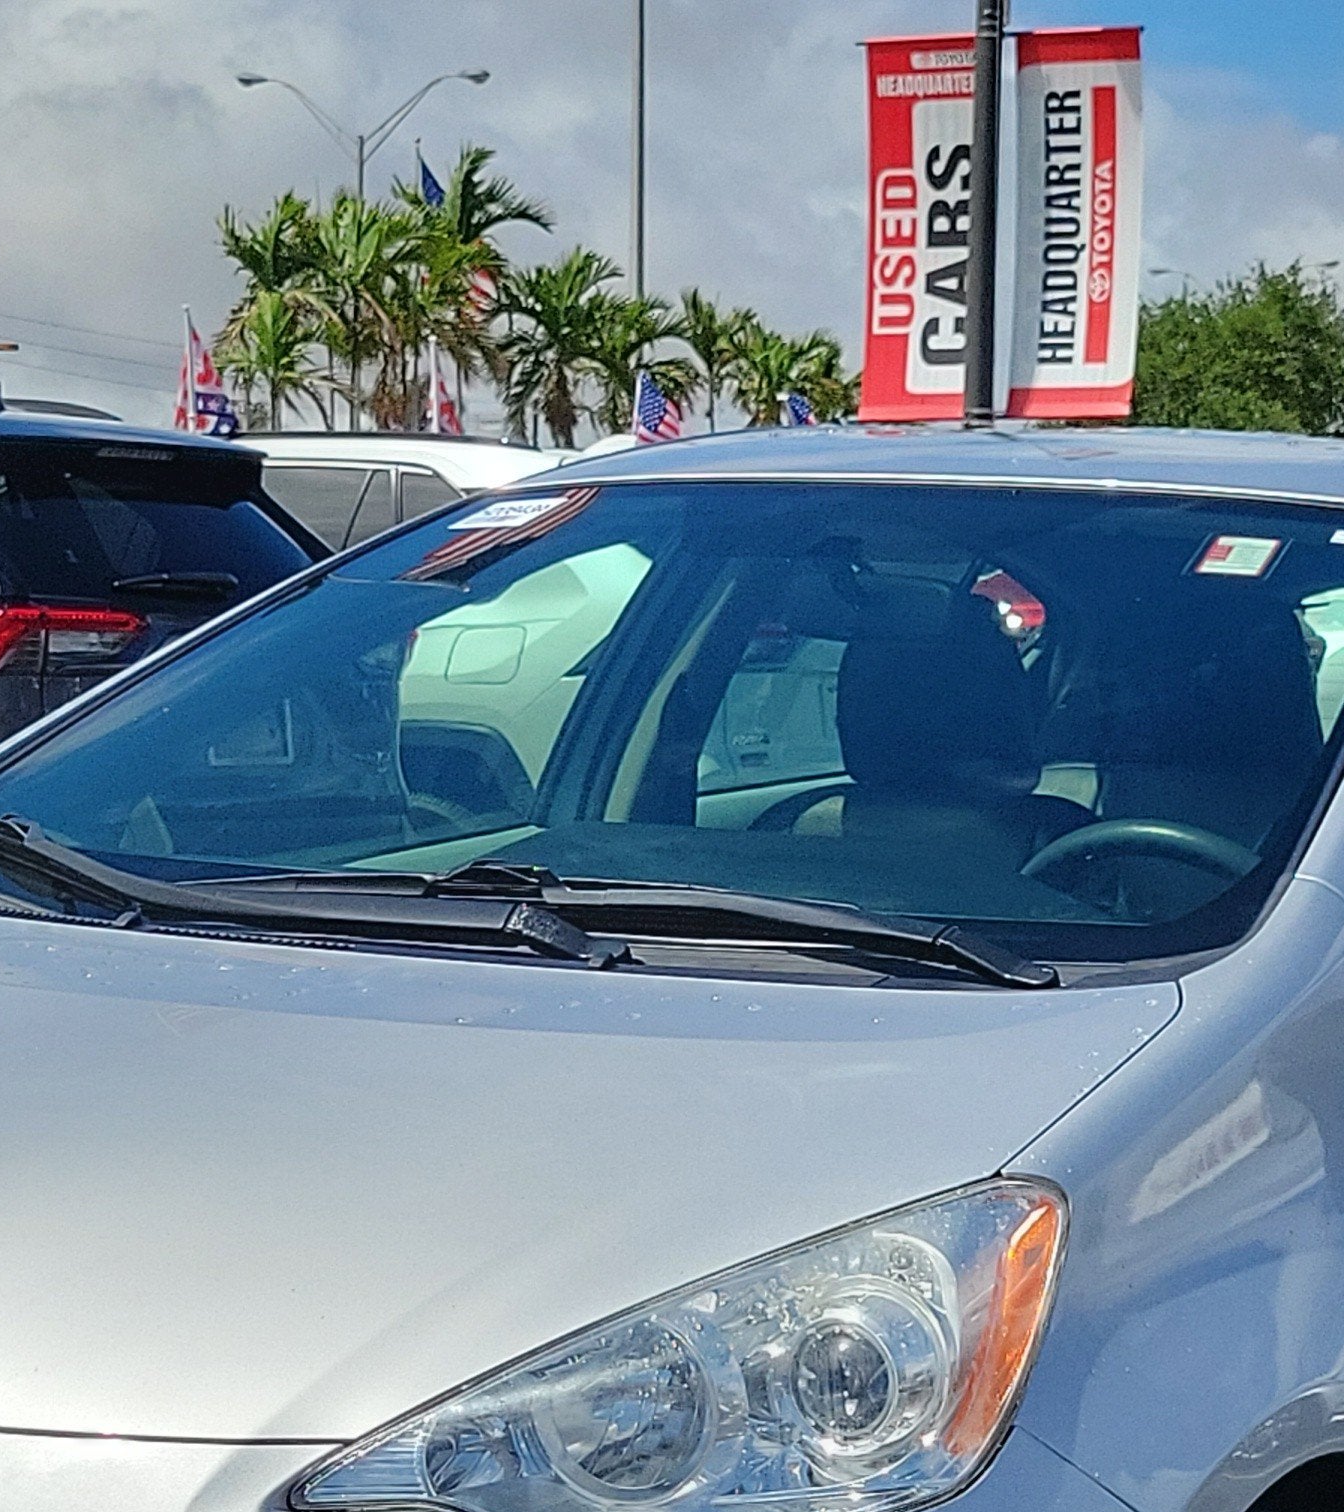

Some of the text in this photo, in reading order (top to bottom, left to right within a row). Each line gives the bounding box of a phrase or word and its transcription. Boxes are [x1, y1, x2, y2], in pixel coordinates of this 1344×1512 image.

[877, 72, 975, 98] HEADQUARTE
[873, 170, 917, 334] USED
[921, 143, 973, 366] CARS
[1037, 89, 1086, 365] HEADQUARTER
[1092, 160, 1114, 269] TOYOTA
